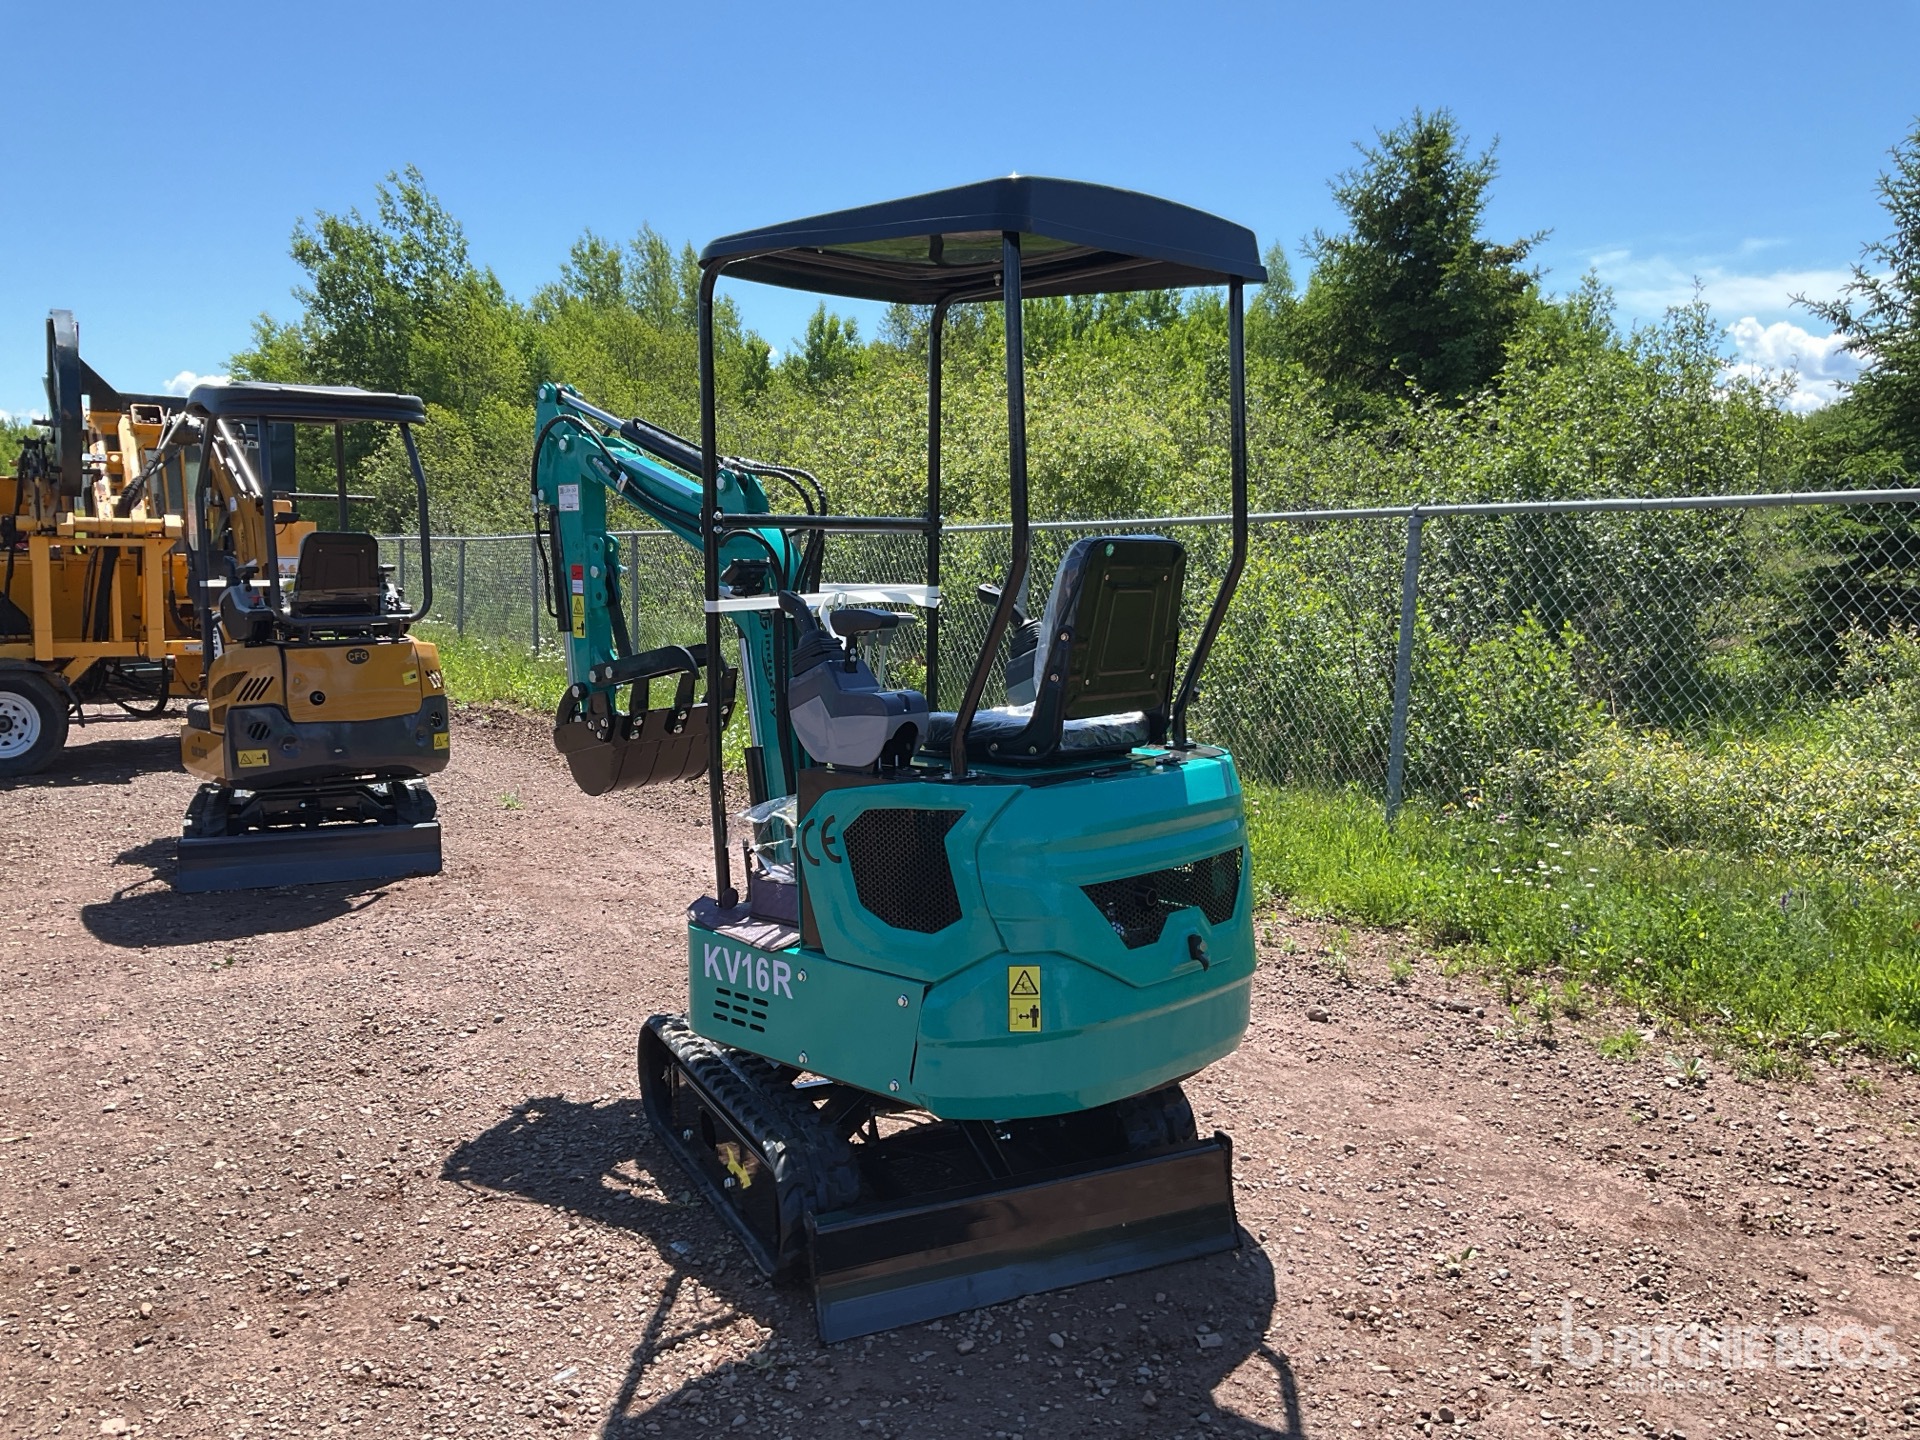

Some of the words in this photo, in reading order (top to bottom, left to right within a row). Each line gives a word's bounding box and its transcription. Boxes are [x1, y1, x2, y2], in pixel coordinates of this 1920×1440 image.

[347, 651, 368, 661] CFG
[802, 815, 842, 866] CE
[704, 943, 794, 999] KV16R
